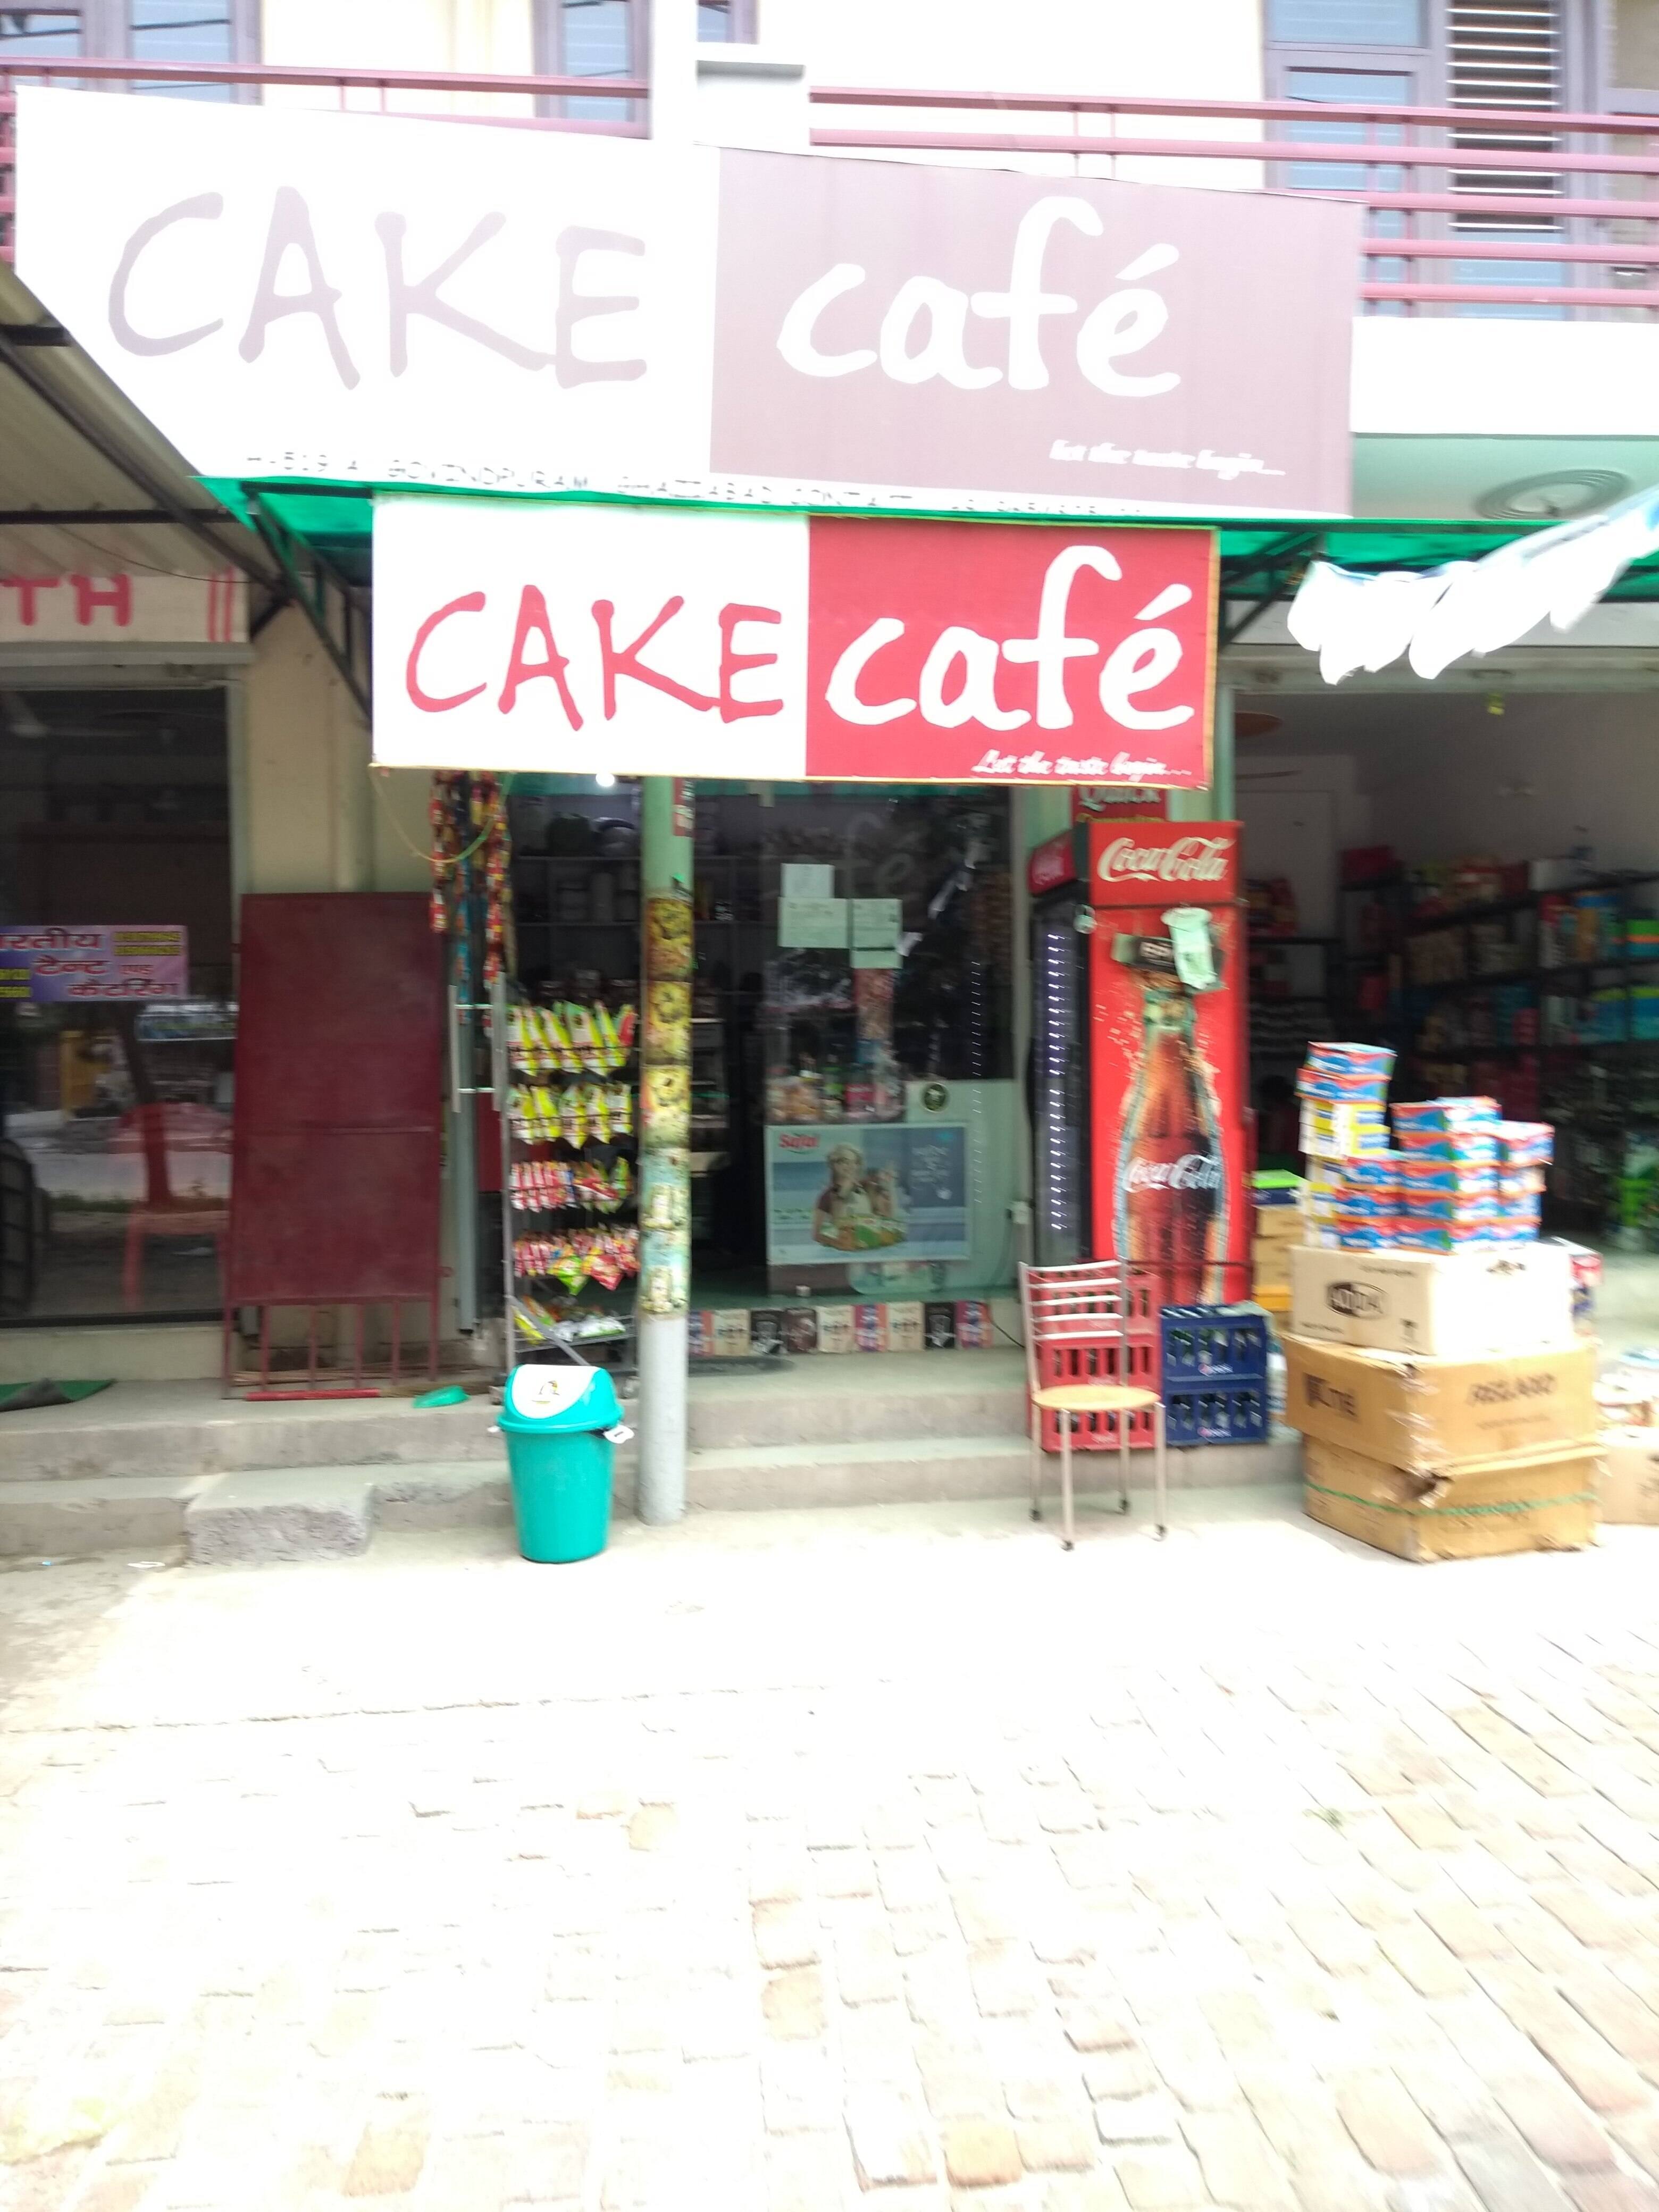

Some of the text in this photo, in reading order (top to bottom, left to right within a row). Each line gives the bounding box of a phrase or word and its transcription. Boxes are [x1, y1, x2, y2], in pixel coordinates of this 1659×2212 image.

[108, 186, 1181, 397] CAKE café
[407, 545, 1195, 731] CAKE café
[1017, 751, 1054, 774] the
